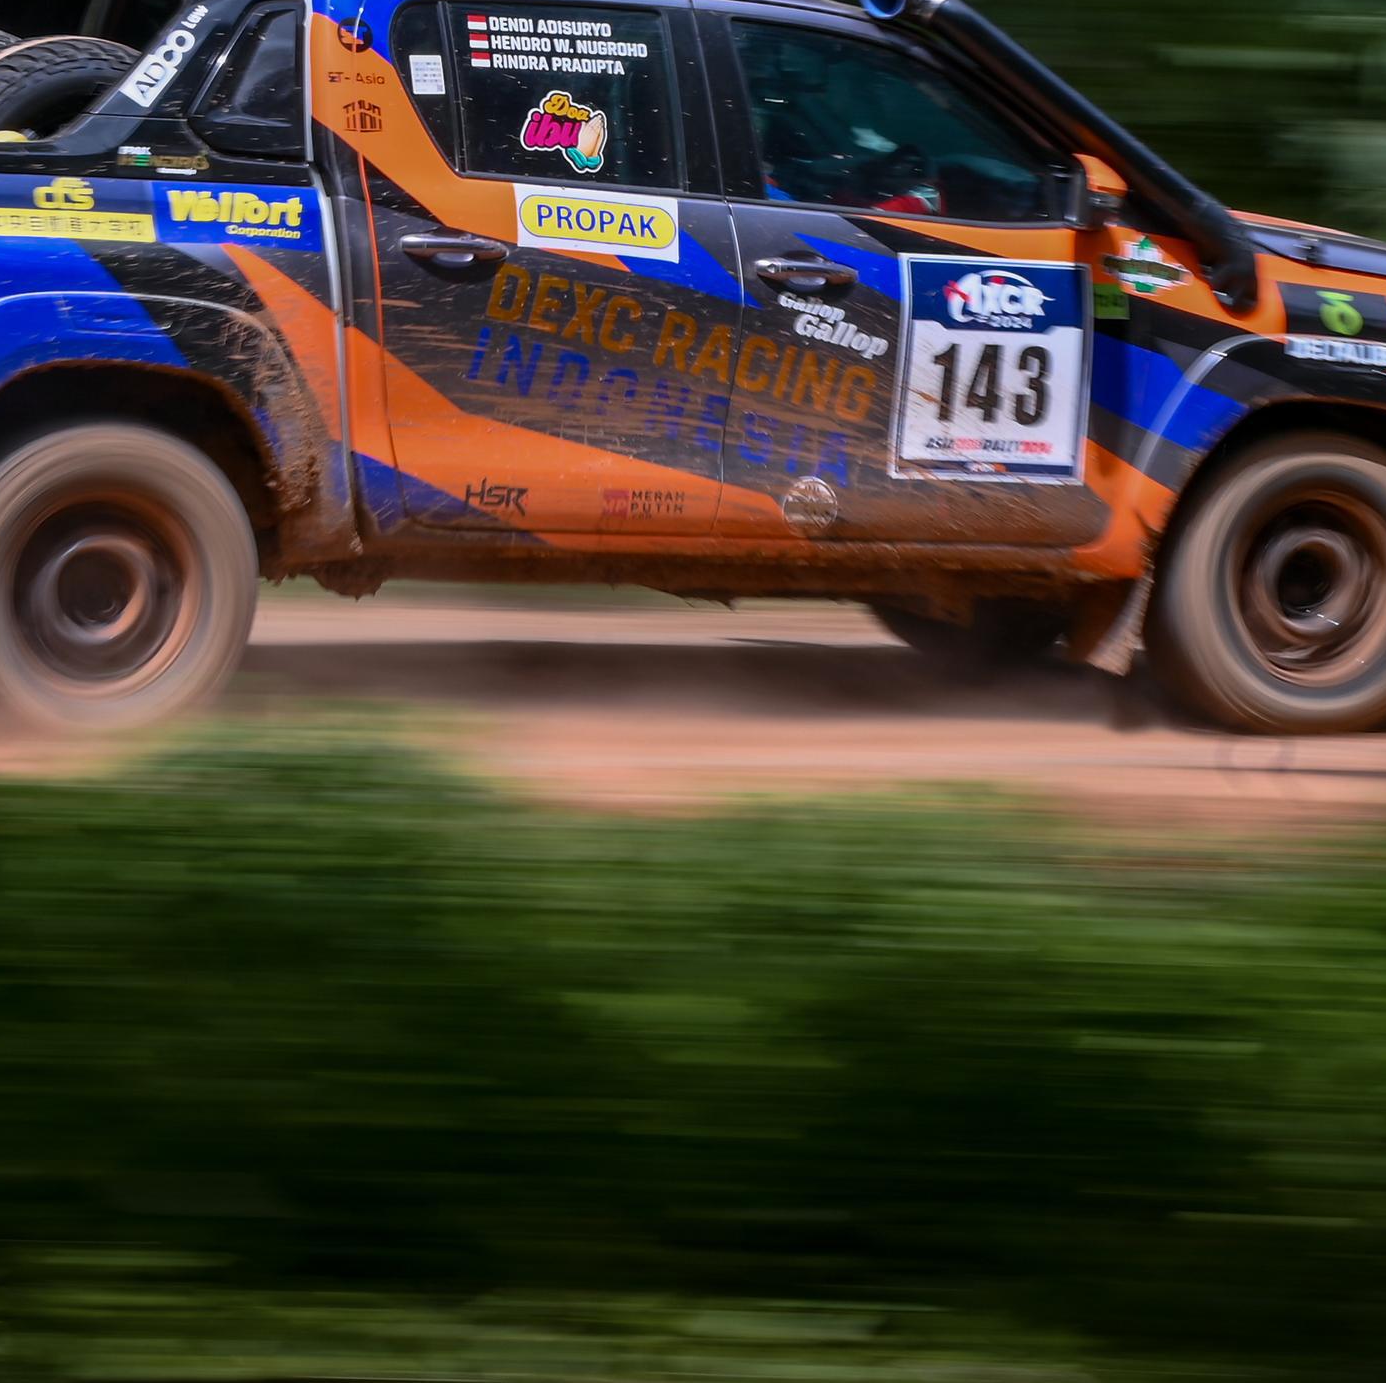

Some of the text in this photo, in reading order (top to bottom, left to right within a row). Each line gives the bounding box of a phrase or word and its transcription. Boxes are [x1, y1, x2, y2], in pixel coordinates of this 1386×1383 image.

[488, 16, 612, 38] DENDI ADISURYO
[490, 34, 649, 58] HENDRO W. NUGROHO
[492, 53, 626, 76] RINDRA PRADIPTA
[543, 93, 591, 122] Doa
[524, 112, 583, 148] ibu
[225, 224, 301, 239] Corporation
[536, 203, 658, 239] PROPAK
[485, 262, 877, 422] DEXC RACING
[793, 313, 889, 360] Gallop
[934, 343, 1050, 428] 143
